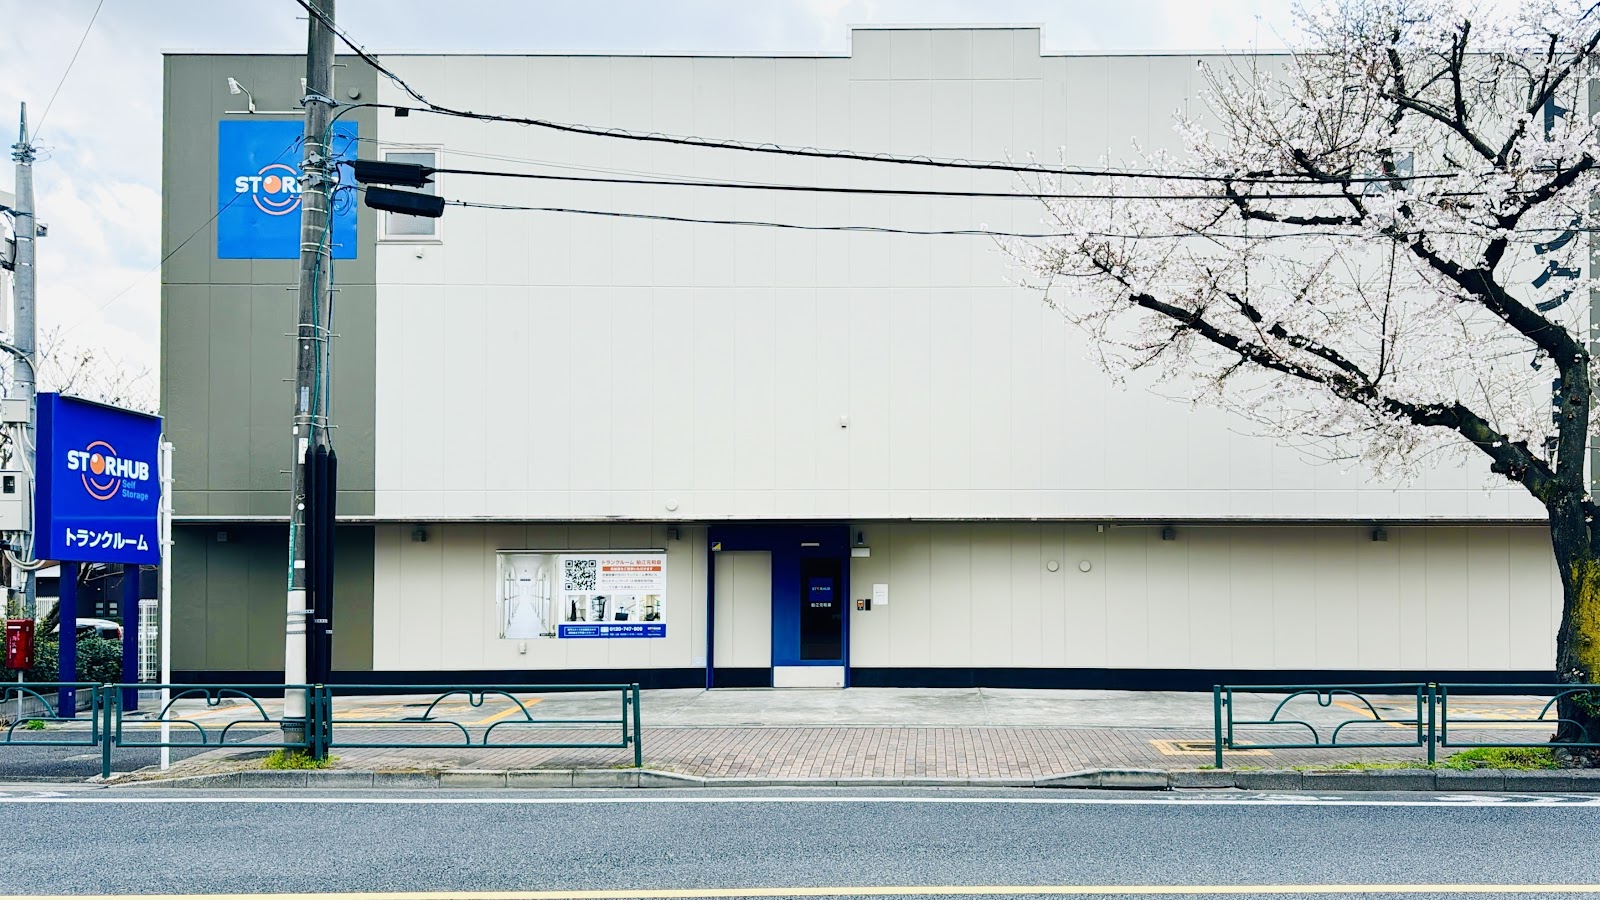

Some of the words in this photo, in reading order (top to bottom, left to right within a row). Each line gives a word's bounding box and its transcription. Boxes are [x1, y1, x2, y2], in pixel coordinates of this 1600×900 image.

[67, 449, 149, 481] STORHUB
[121, 479, 136, 490] Self
[121, 488, 149, 502] Storage
[65, 527, 149, 551] トランクルーム
